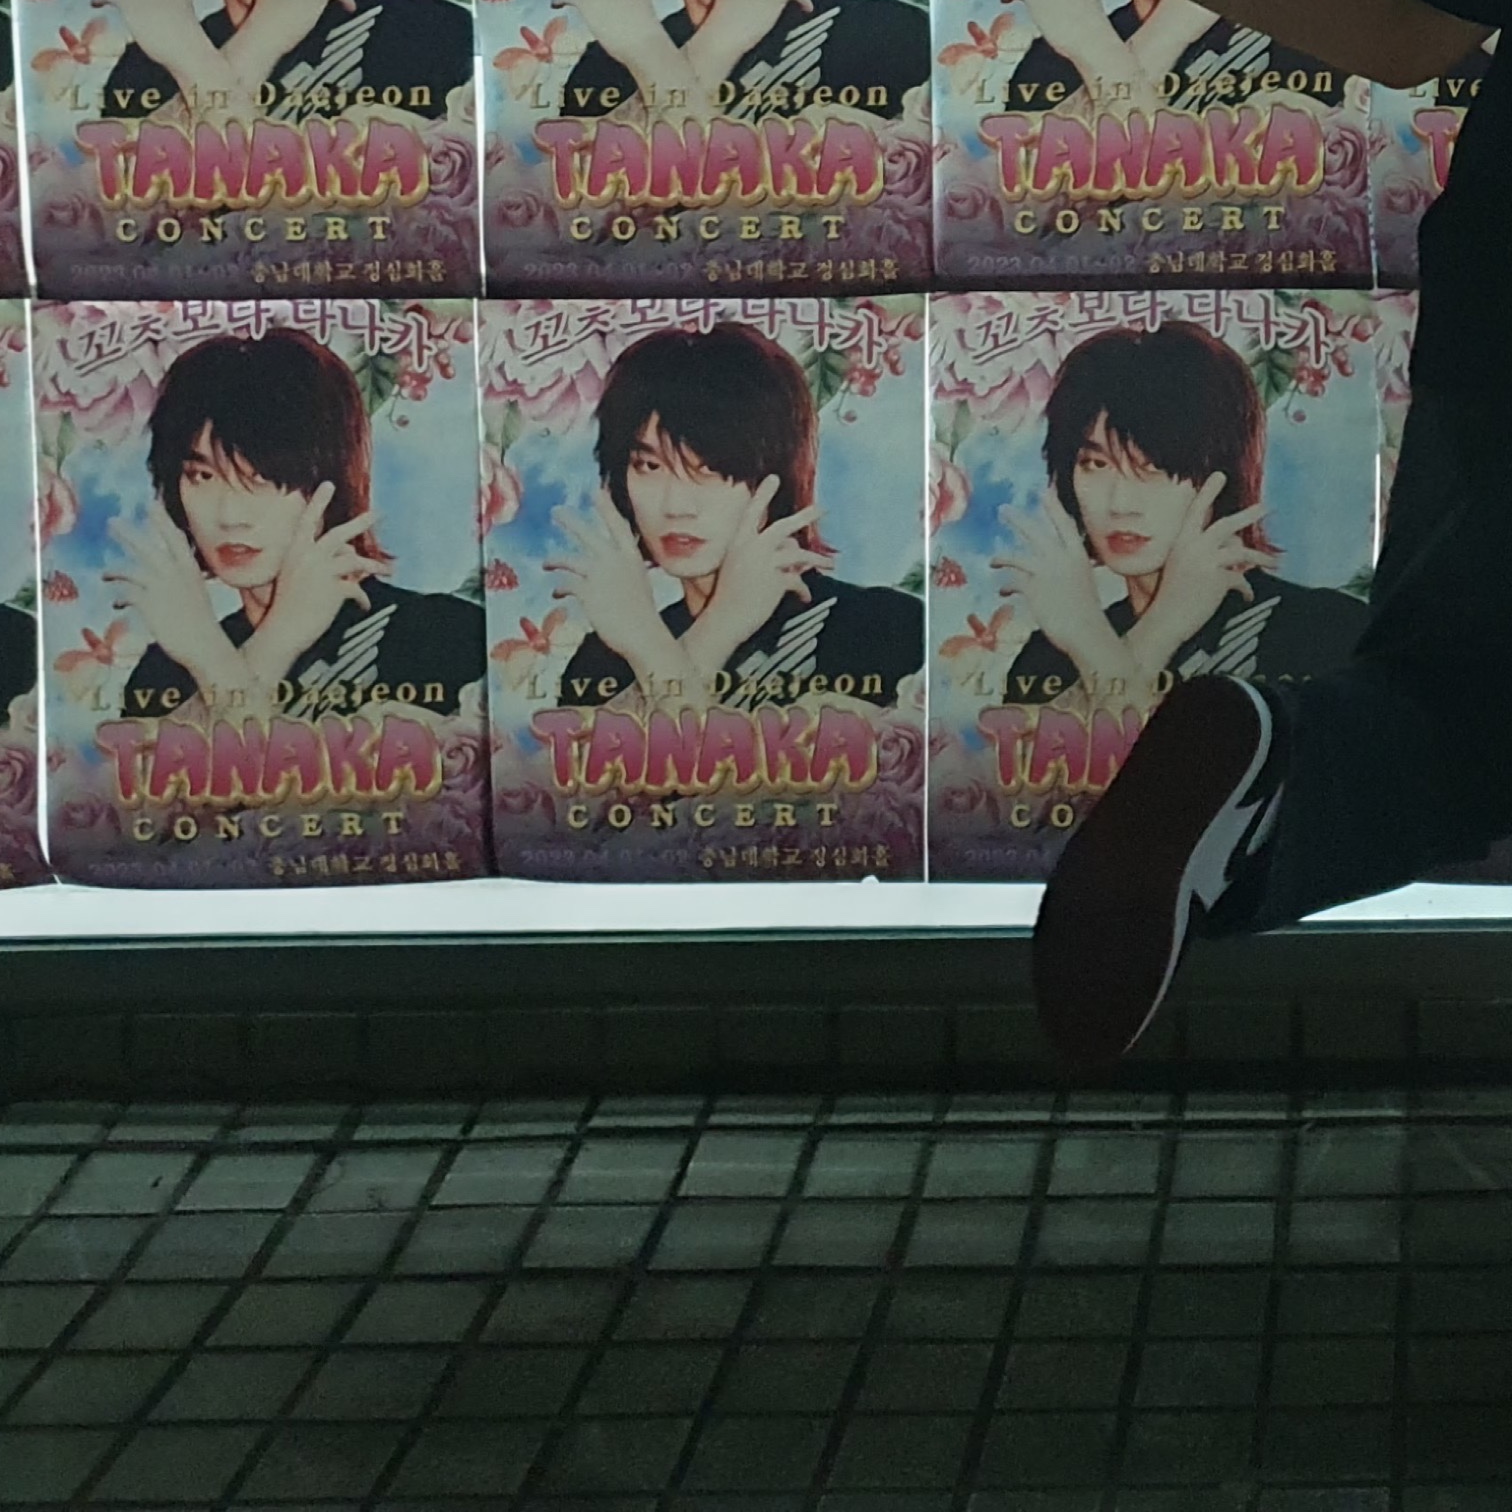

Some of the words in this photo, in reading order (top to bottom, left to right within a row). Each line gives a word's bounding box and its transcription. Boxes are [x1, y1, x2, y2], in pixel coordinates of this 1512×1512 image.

[69, 84, 162, 111] Live
[252, 78, 431, 111] Daejeon
[530, 82, 621, 109] Live
[712, 78, 890, 110] Daejeon
[974, 77, 1065, 104] Live
[1161, 65, 1333, 96] Daejeon
[72, 112, 432, 212] TANAKA
[532, 112, 887, 210] TANAKA
[977, 104, 1326, 203] TANAKA
[113, 212, 391, 245] CONCERT
[569, 212, 846, 242] CONCERT
[1013, 203, 1285, 236] CONCERT
[91, 683, 181, 711] Live
[270, 675, 445, 709] Daejeon
[527, 673, 617, 699] Live
[708, 667, 883, 699] Daejeon
[94, 707, 445, 812] TANAKA
[529, 700, 880, 799] TANAKA
[132, 807, 405, 843] CONCERT
[565, 799, 839, 831] CONCERT
